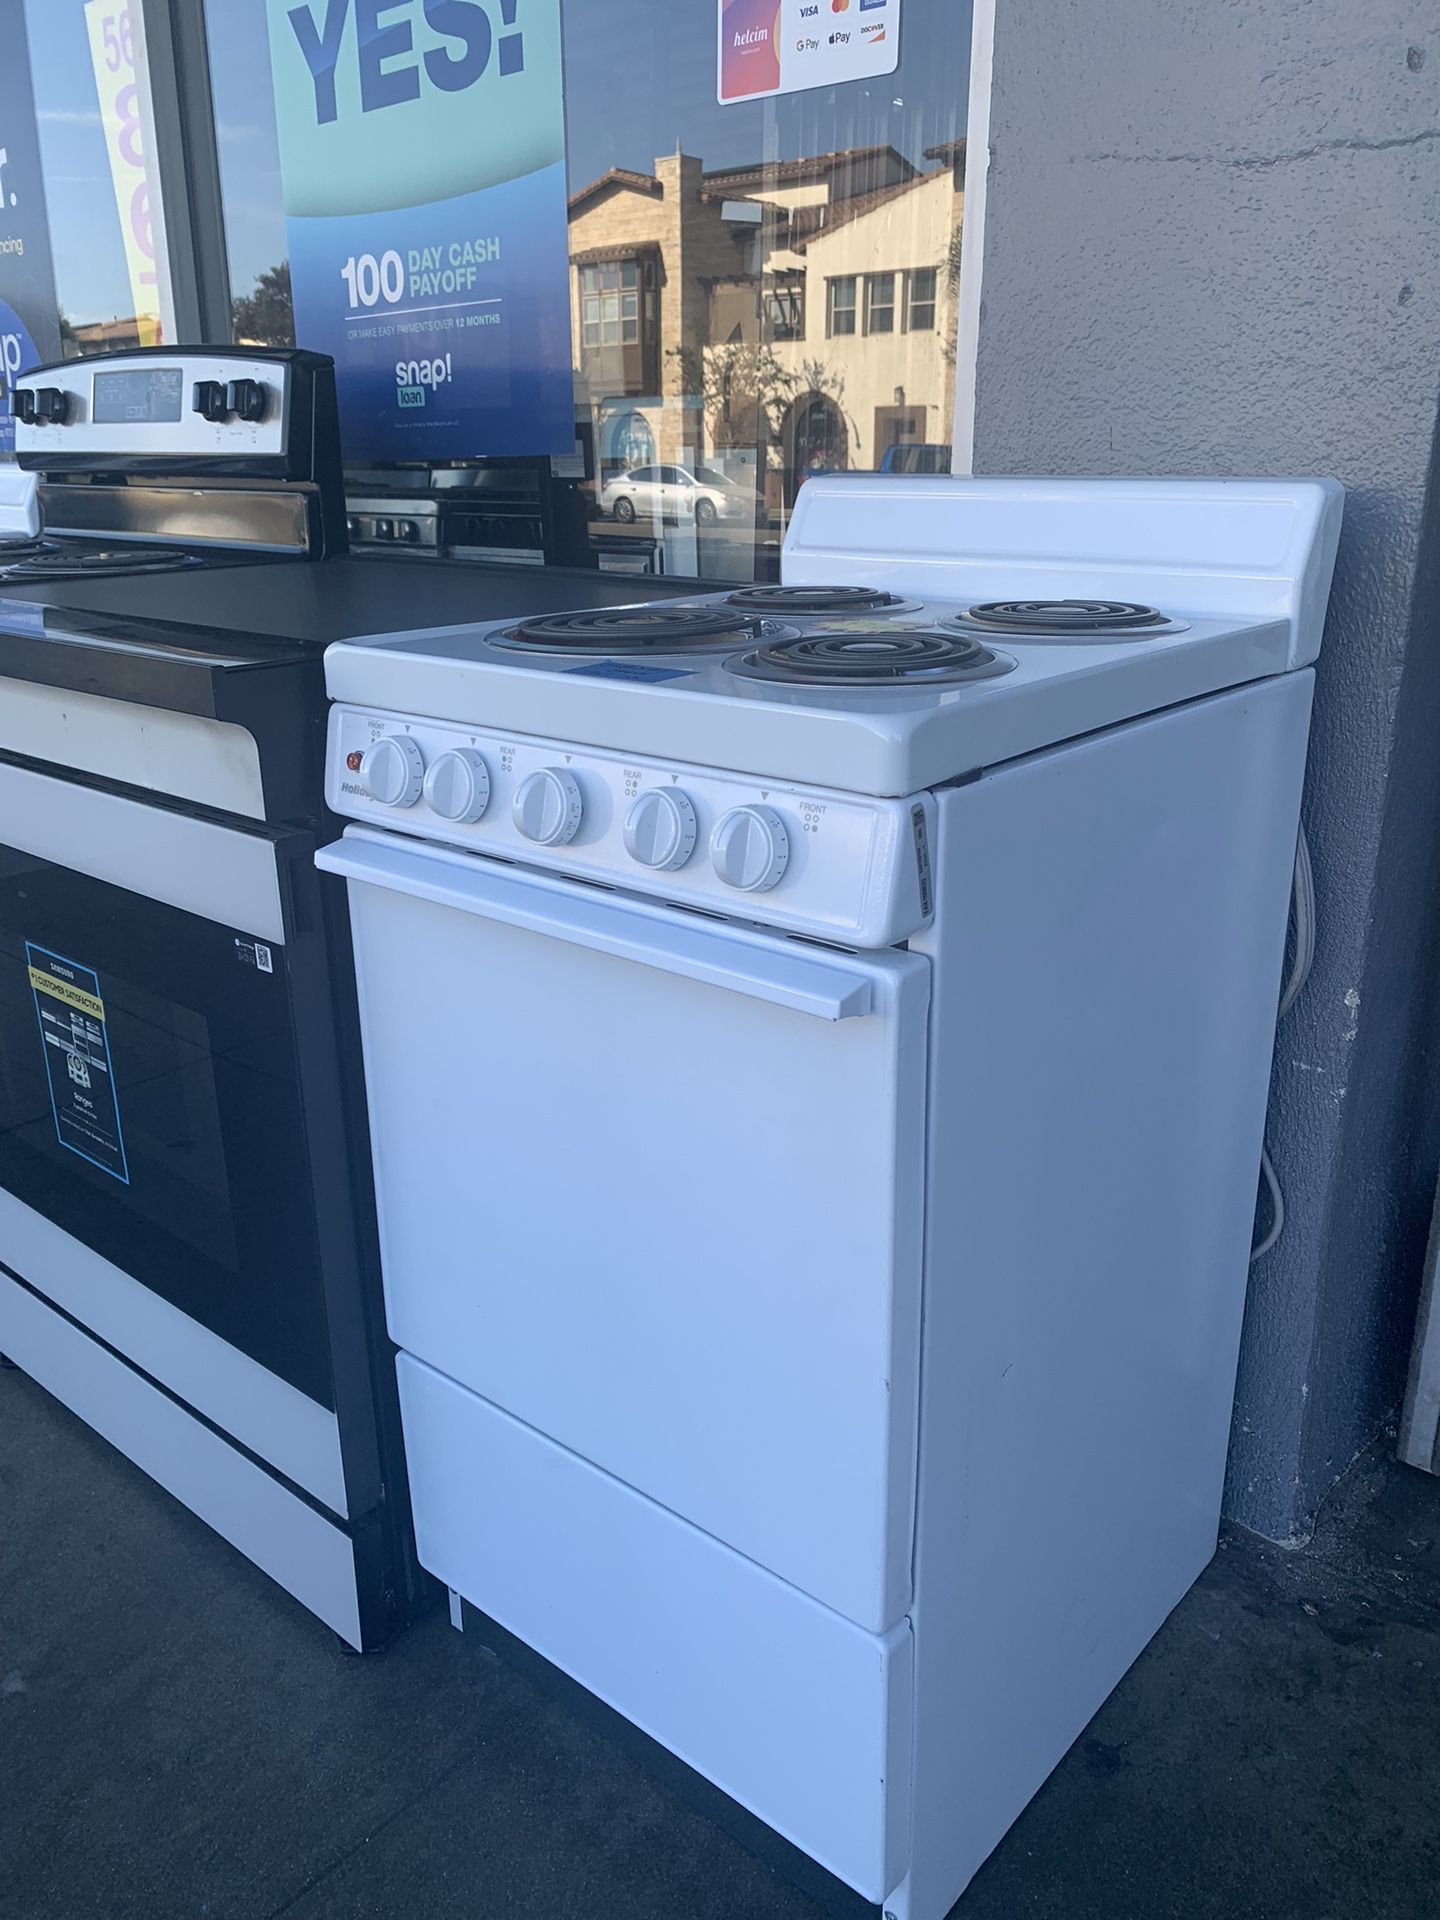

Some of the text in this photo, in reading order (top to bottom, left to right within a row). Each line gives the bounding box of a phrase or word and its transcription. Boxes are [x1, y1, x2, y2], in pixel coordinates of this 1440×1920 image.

[799, 5, 819, 18] VISA
[733, 25, 768, 47] helcim
[805, 38, 820, 51] Pay
[835, 32, 851, 44] Pay
[283, 0, 524, 125] YES!
[341, 236, 500, 308] 100 DAY CASH
[409, 266, 477, 297] PAYOFF
[347, 313, 500, 340] OR MAKE EASY PAYMENTS OVER 12 MONTHS
[395, 352, 452, 391] snap!
[400, 389, 422, 404] loan
[623, 768, 642, 780] REAR
[799, 802, 828, 814] FRONT
[37, 976, 65, 996] CUSTOMER
[65, 989, 102, 1013] SATISFACTION
